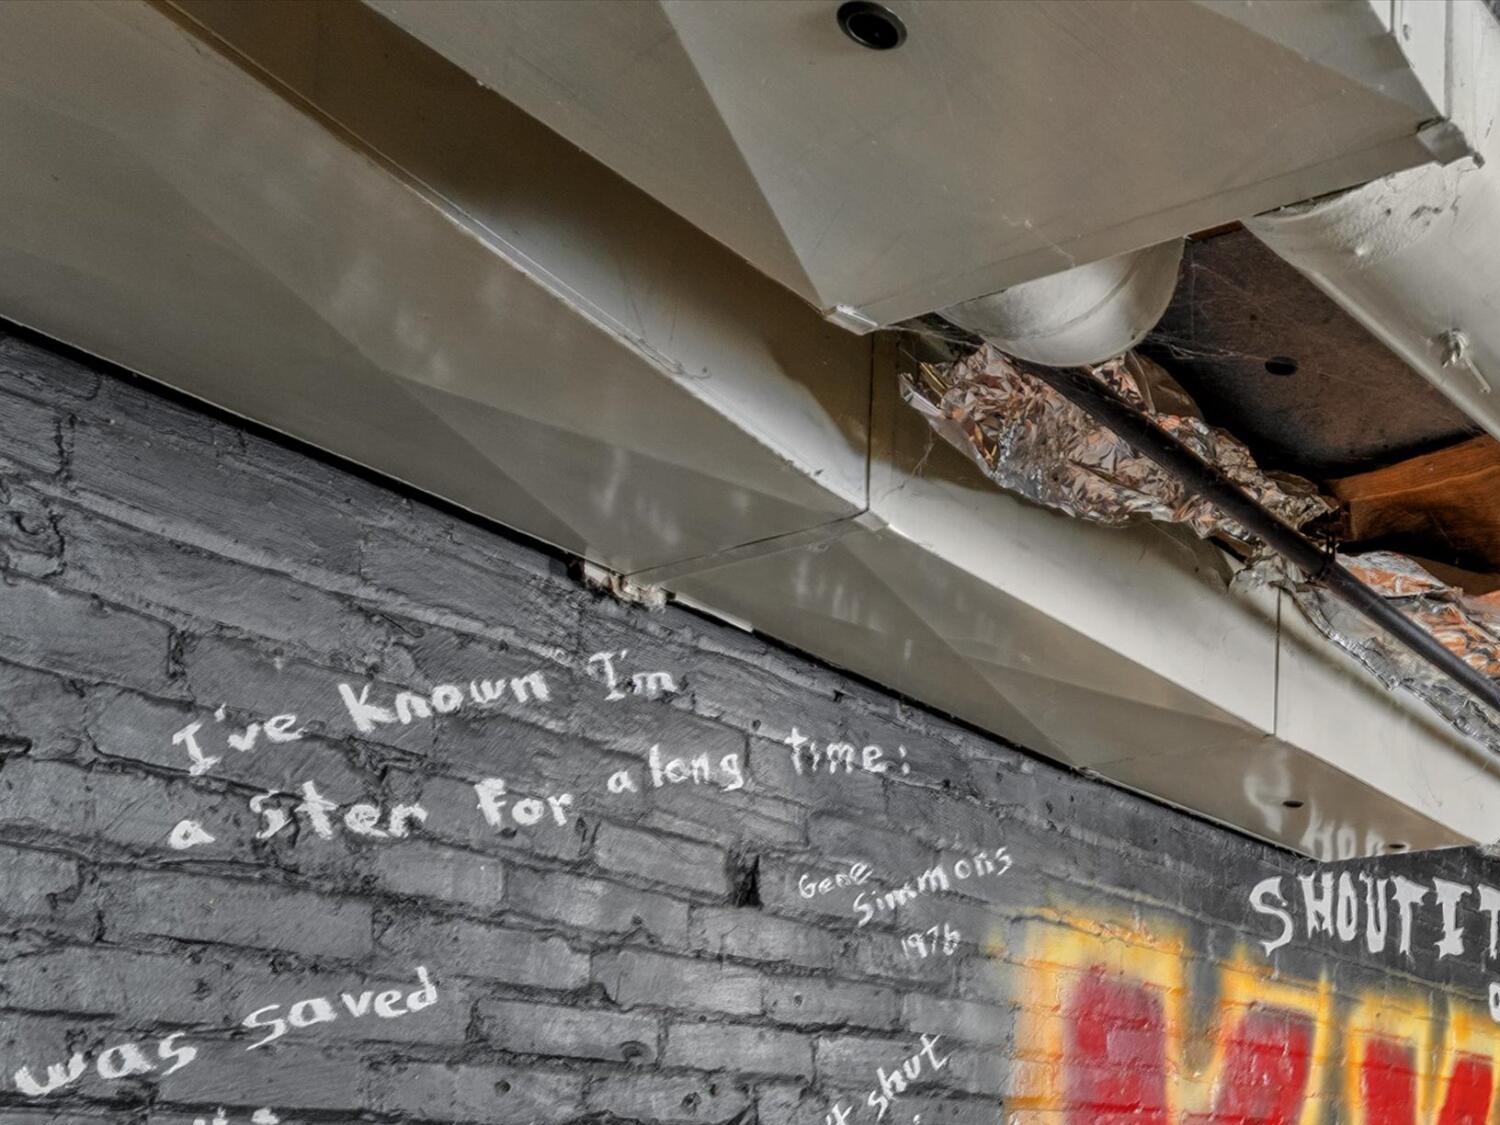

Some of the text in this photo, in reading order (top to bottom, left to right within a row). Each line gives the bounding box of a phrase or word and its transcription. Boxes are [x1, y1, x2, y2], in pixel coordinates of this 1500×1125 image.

[171, 648, 679, 776] I've Known I'm
[167, 819, 216, 850] a
[606, 768, 638, 794] a
[648, 742, 745, 793] long
[797, 860, 875, 900] Gene
[1248, 870, 1429, 958] SHOUT
[11, 965, 441, 1097] was saved
[867, 1032, 953, 1122] shut
